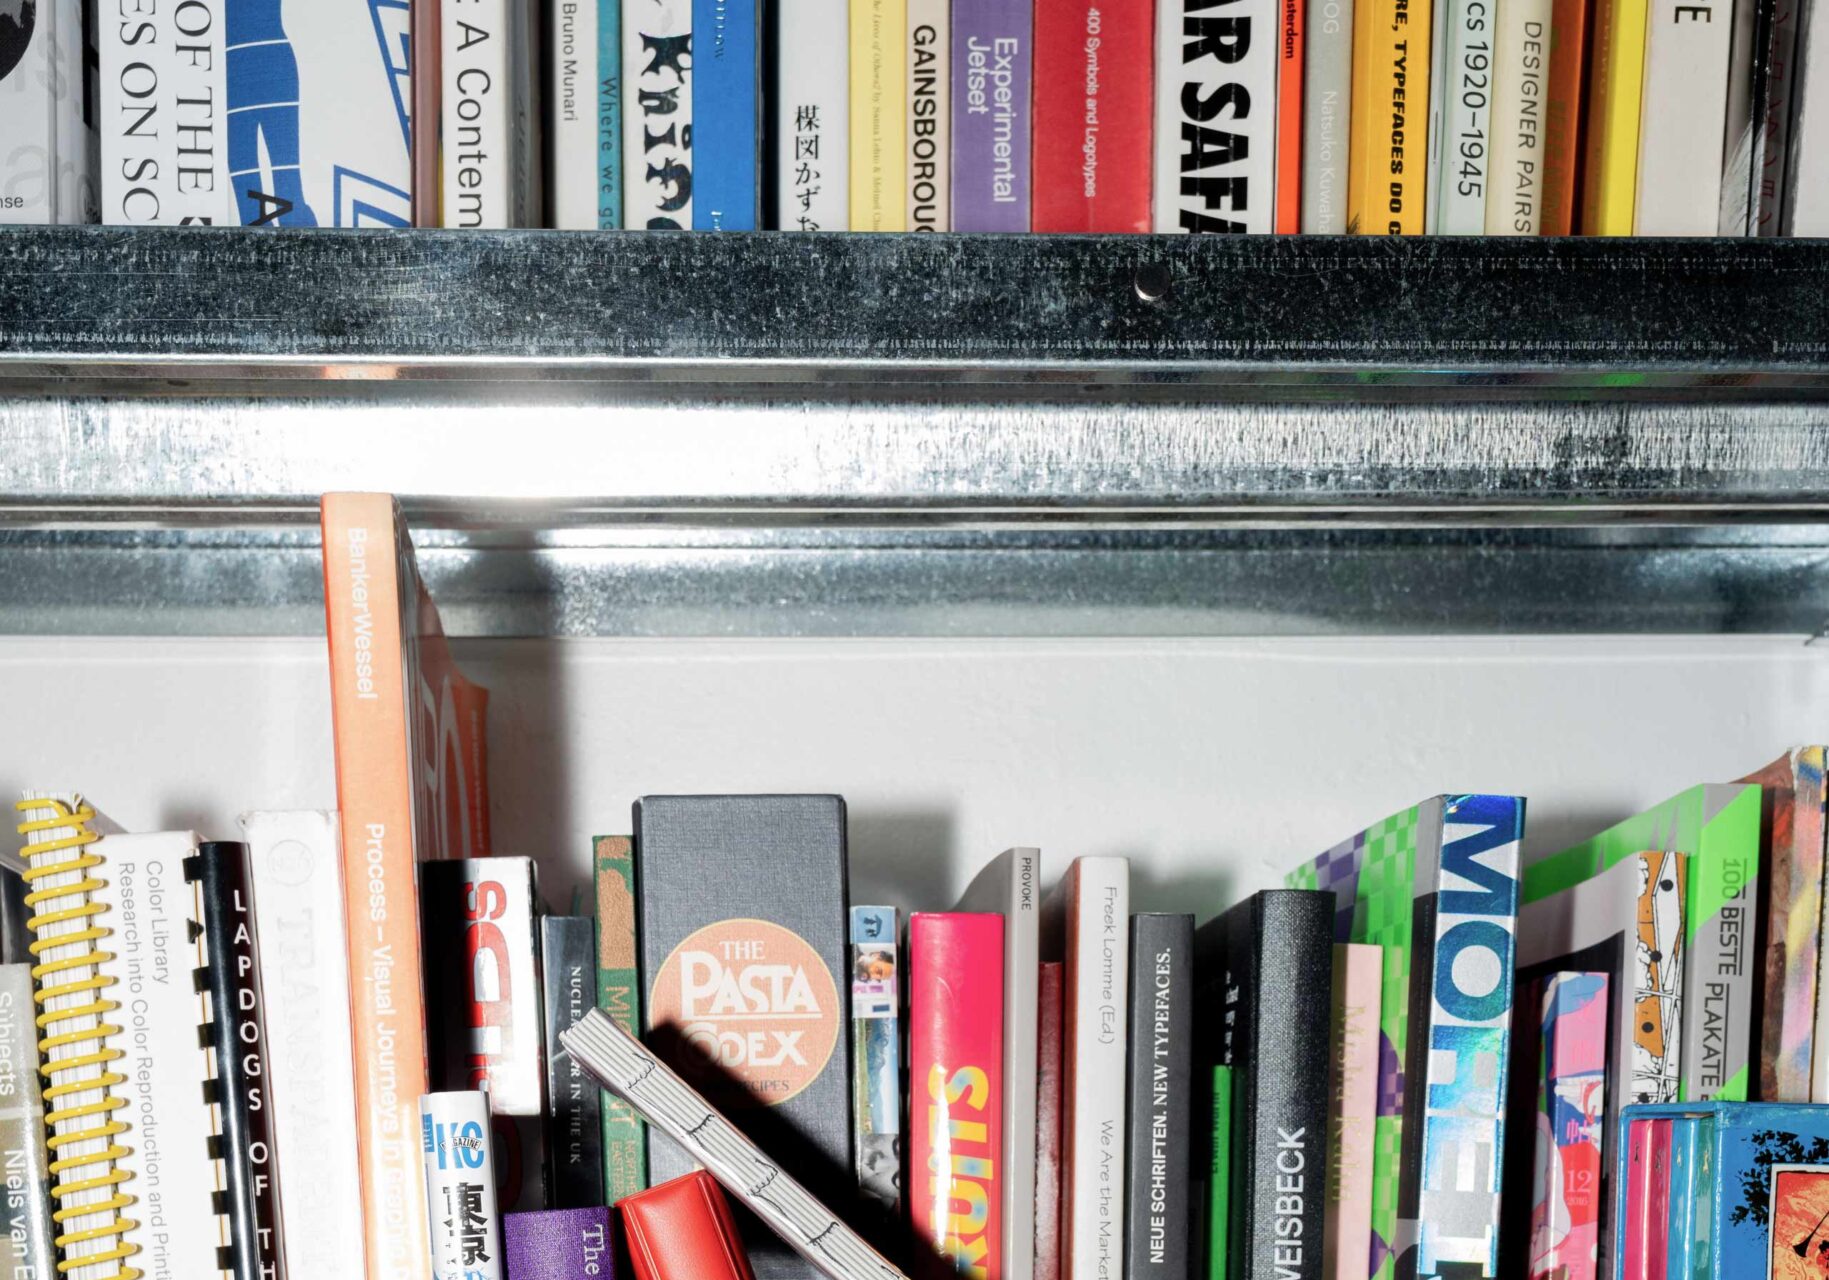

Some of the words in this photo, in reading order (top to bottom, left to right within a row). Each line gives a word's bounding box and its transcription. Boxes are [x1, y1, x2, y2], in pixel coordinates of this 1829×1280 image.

[174, 0, 212, 71] OF
[456, 21, 490, 52] A
[562, 3, 578, 56] Bruno
[1088, 7, 1101, 35] 400
[562, 60, 579, 121] Munari
[968, 36, 991, 115] Jetset
[1084, 37, 1101, 96] Symbols
[1518, 21, 1543, 149] DESIGNER
[120, 62, 158, 140] ON
[601, 77, 618, 151] Where
[989, 36, 1018, 203] Experimental
[1086, 98, 1100, 125] and
[1318, 91, 1339, 162] Natsuko
[1389, 40, 1408, 175] TYPEFACES
[176, 86, 214, 194] THE
[456, 69, 491, 228] Contem
[1082, 127, 1099, 198] Logotypes
[121, 158, 160, 221] SC
[602, 166, 614, 194] we
[1388, 182, 1403, 214] DO
[1513, 159, 1536, 234] PAIRS
[346, 527, 379, 700] BankerWessel
[146, 860, 164, 914] Color
[365, 822, 387, 921] Process
[1021, 856, 1033, 911] PROVOKE
[1722, 857, 1741, 900] 100
[119, 862, 143, 957] Research
[1103, 885, 1119, 935] Freek
[149, 917, 171, 985] Library
[719, 940, 766, 961] THE
[1101, 937, 1116, 1000] Lomme
[1718, 907, 1740, 976] BESTE
[127, 962, 143, 994] into
[372, 944, 395, 1014] Visual
[680, 949, 823, 1021] PASTA
[1154, 948, 1172, 1060] TYPEFACES.
[131, 999, 150, 1052] Color
[233, 889, 262, 1111] LAPDOGS
[249, 1142, 269, 1197] OF
[1098, 1004, 1116, 1046] (Ed.)
[1701, 982, 1724, 1087] PLAKATE
[375, 1021, 400, 1133] Journeys
[569, 1083, 582, 1101] IN
[1153, 1064, 1169, 1107] NEW
[135, 1056, 160, 1187] Reproduction
[436, 1121, 485, 1169] KC
[568, 1106, 582, 1138] THE
[1100, 1119, 1115, 1153] We
[4, 1149, 24, 1210] Niels
[568, 1142, 582, 1165] UK
[1100, 1155, 1114, 1184] Are
[1150, 1110, 1167, 1213] SCHRIFTEN.
[1567, 1169, 1593, 1194] 12
[148, 1191, 164, 1228] and
[1099, 1186, 1113, 1218] the
[11, 1214, 28, 1256] van
[582, 1224, 604, 1277] The
[1149, 1216, 1165, 1264] NEUE
